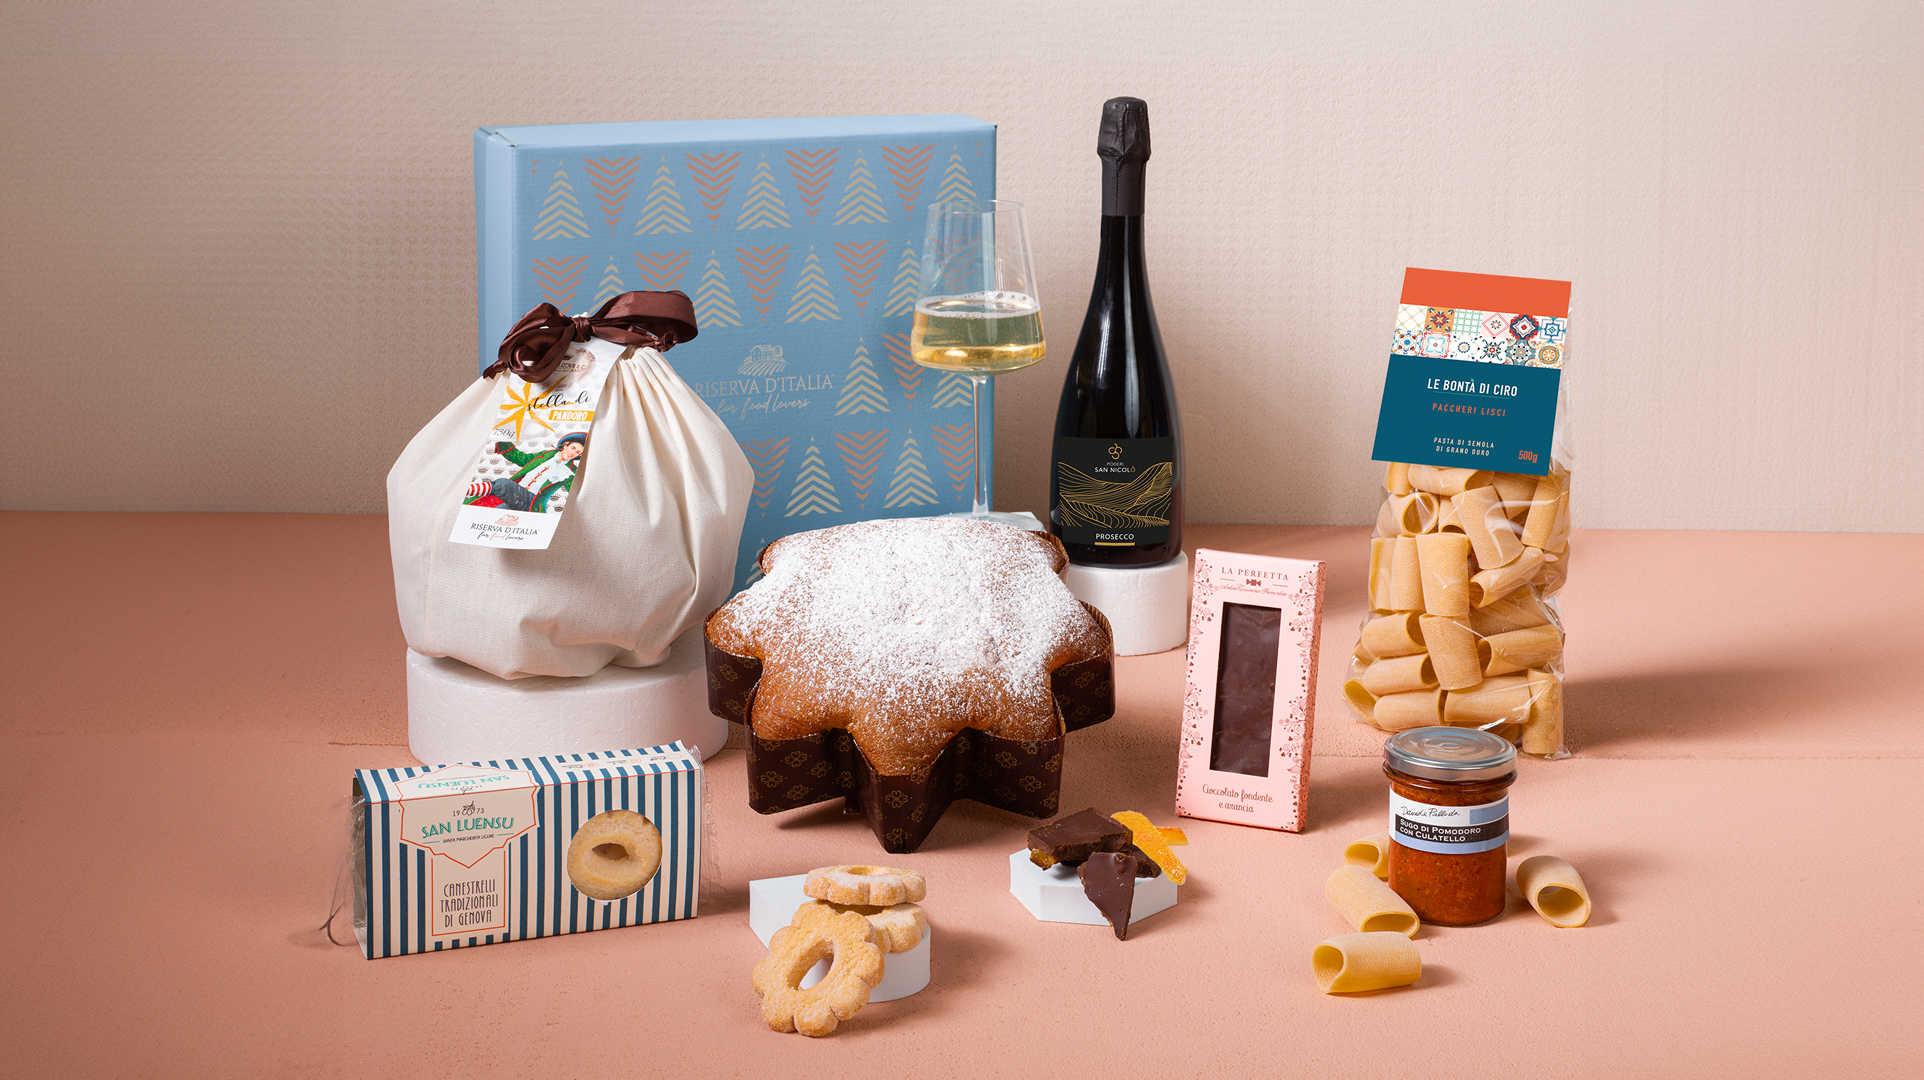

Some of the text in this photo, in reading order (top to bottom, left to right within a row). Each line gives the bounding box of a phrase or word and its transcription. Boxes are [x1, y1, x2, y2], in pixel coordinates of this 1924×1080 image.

[694, 379, 760, 399] RISERVA
[1427, 378, 1518, 397] LE BONTÀ DI CIRO
[526, 390, 592, 411] stella di
[716, 393, 811, 420] for food lovers
[552, 410, 588, 421] PANDORO
[1432, 402, 1507, 417] PACCHERI LISCI
[493, 428, 515, 439] 750g
[1433, 437, 1455, 445] PASTA
[1467, 440, 1495, 449] SEMOLA
[1446, 446, 1469, 455] GRANO
[1471, 449, 1490, 457] DURO
[1518, 450, 1538, 464] 500g
[470, 522, 503, 533] RISERVA
[1095, 533, 1135, 541] PROSECCO
[1221, 566, 1289, 581] LA PERFETTA
[418, 780, 476, 789] LUENSU
[480, 775, 510, 784] SAN
[1202, 783, 1274, 803] Cioccolato fondente
[452, 809, 460, 817] 19
[1225, 803, 1255, 813] arancia
[421, 816, 515, 839] SAN LUENSU
[443, 879, 496, 898] CANESTRELLI
[440, 894, 499, 913] TRADIZIONALI
[444, 909, 492, 928] DI GENOVA
